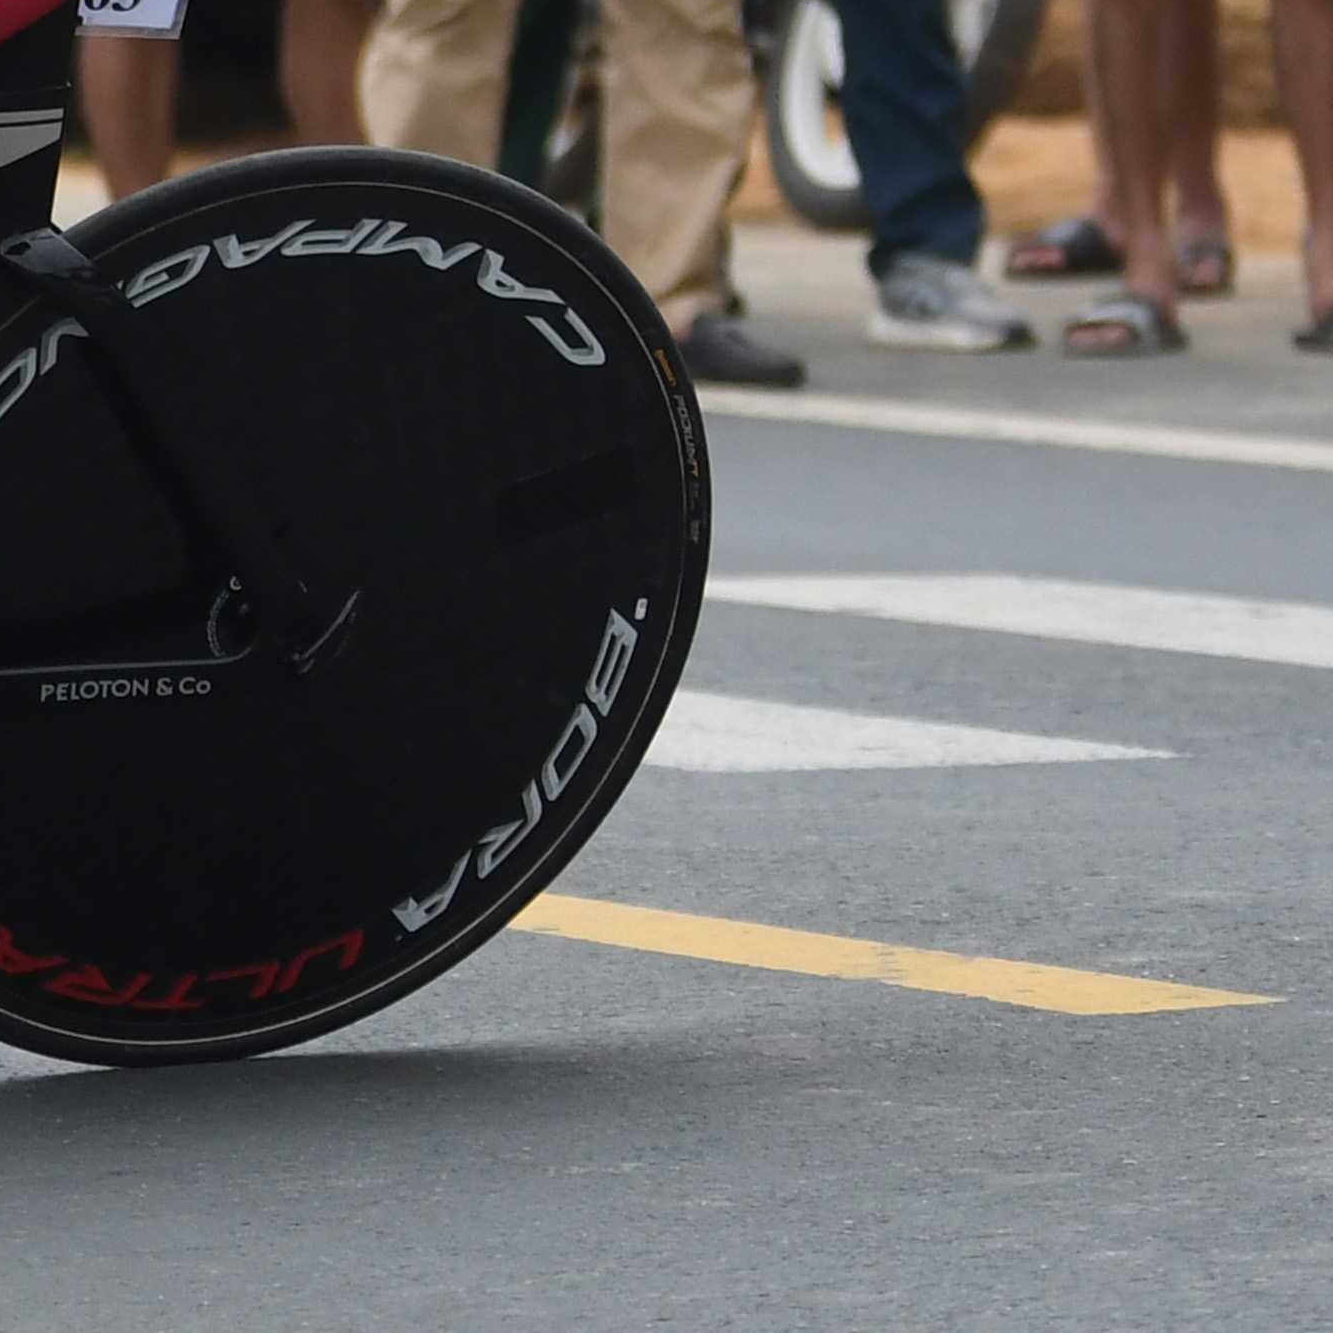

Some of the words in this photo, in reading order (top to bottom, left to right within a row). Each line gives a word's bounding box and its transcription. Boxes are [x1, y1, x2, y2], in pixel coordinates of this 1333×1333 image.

[40, 679, 149, 704] PELOTON
[156, 677, 174, 697] &
[179, 675, 212, 696] Co
[391, 607, 639, 933] BORA
